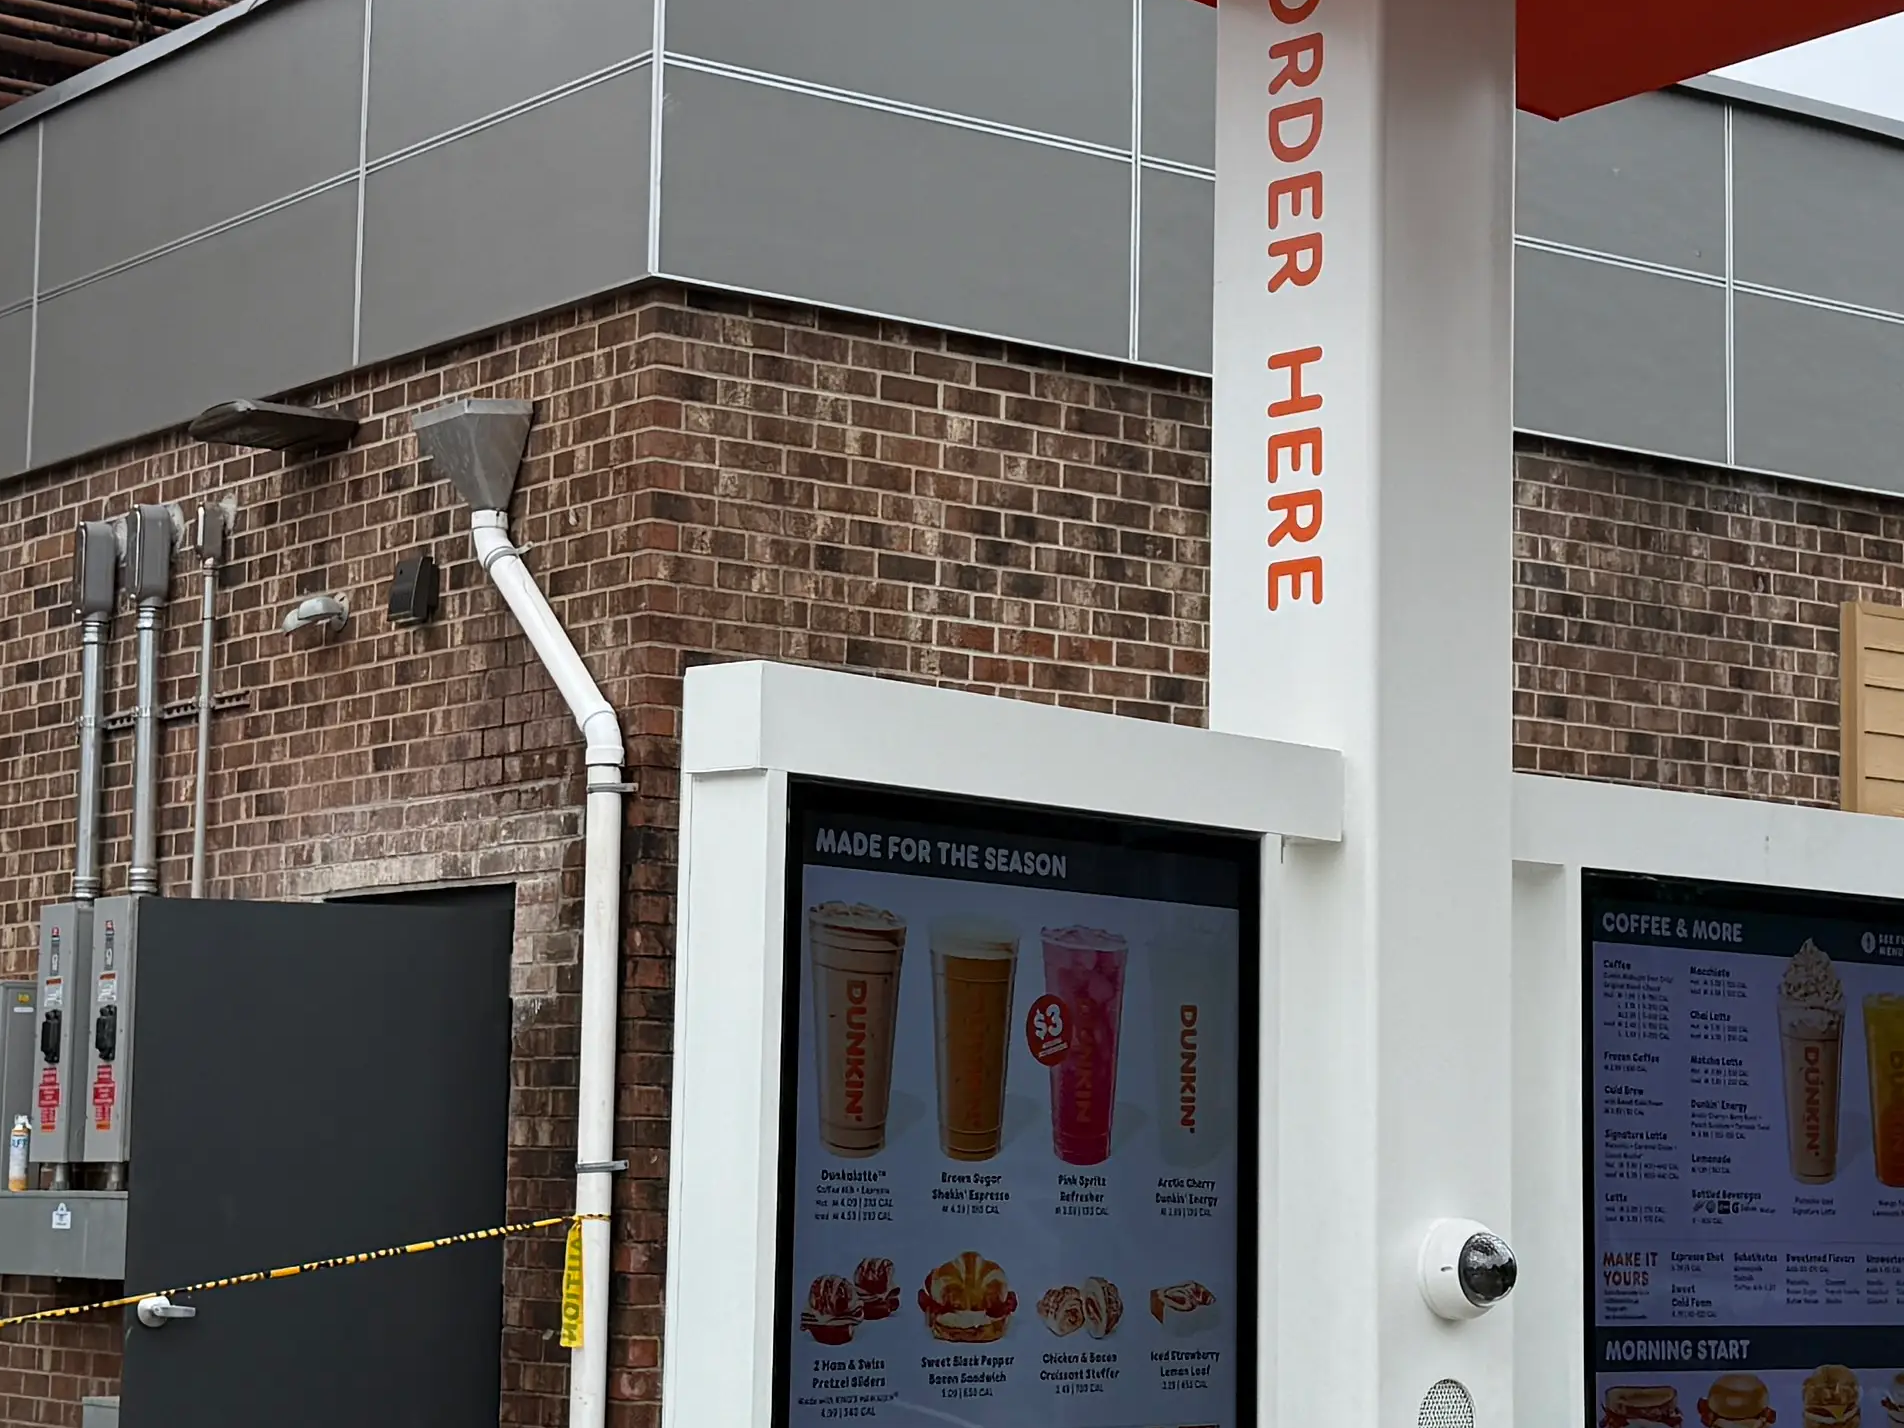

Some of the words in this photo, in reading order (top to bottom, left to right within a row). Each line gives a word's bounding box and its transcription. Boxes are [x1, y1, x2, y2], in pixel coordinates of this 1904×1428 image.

[1267, 345, 1323, 611] HERE
[816, 828, 882, 858] MADE
[889, 836, 931, 863] FOR
[937, 842, 978, 869] THE
[984, 847, 1066, 878] SEASON
[1602, 913, 1672, 936] COFFEE
[1676, 919, 1688, 938] &
[1693, 920, 1743, 942] MORE
[1034, 1004, 1063, 1040] $3
[845, 980, 866, 1122] DUNKIN'
[1180, 1005, 1197, 1134] DUNKIN'
[1805, 1047, 1820, 1156] DUNKIN'
[1603, 1252, 1640, 1267] MAKE
[1647, 1252, 1658, 1267] IT
[1604, 1271, 1649, 1286] YOURS
[1151, 1351, 1169, 1361] Iced
[1606, 1340, 1693, 1360] MORNING
[1698, 1340, 1750, 1359] START
[822, 1360, 846, 1371] Ham
[813, 1378, 849, 1389] Pretzel
[851, 1376, 885, 1387] Sliders
